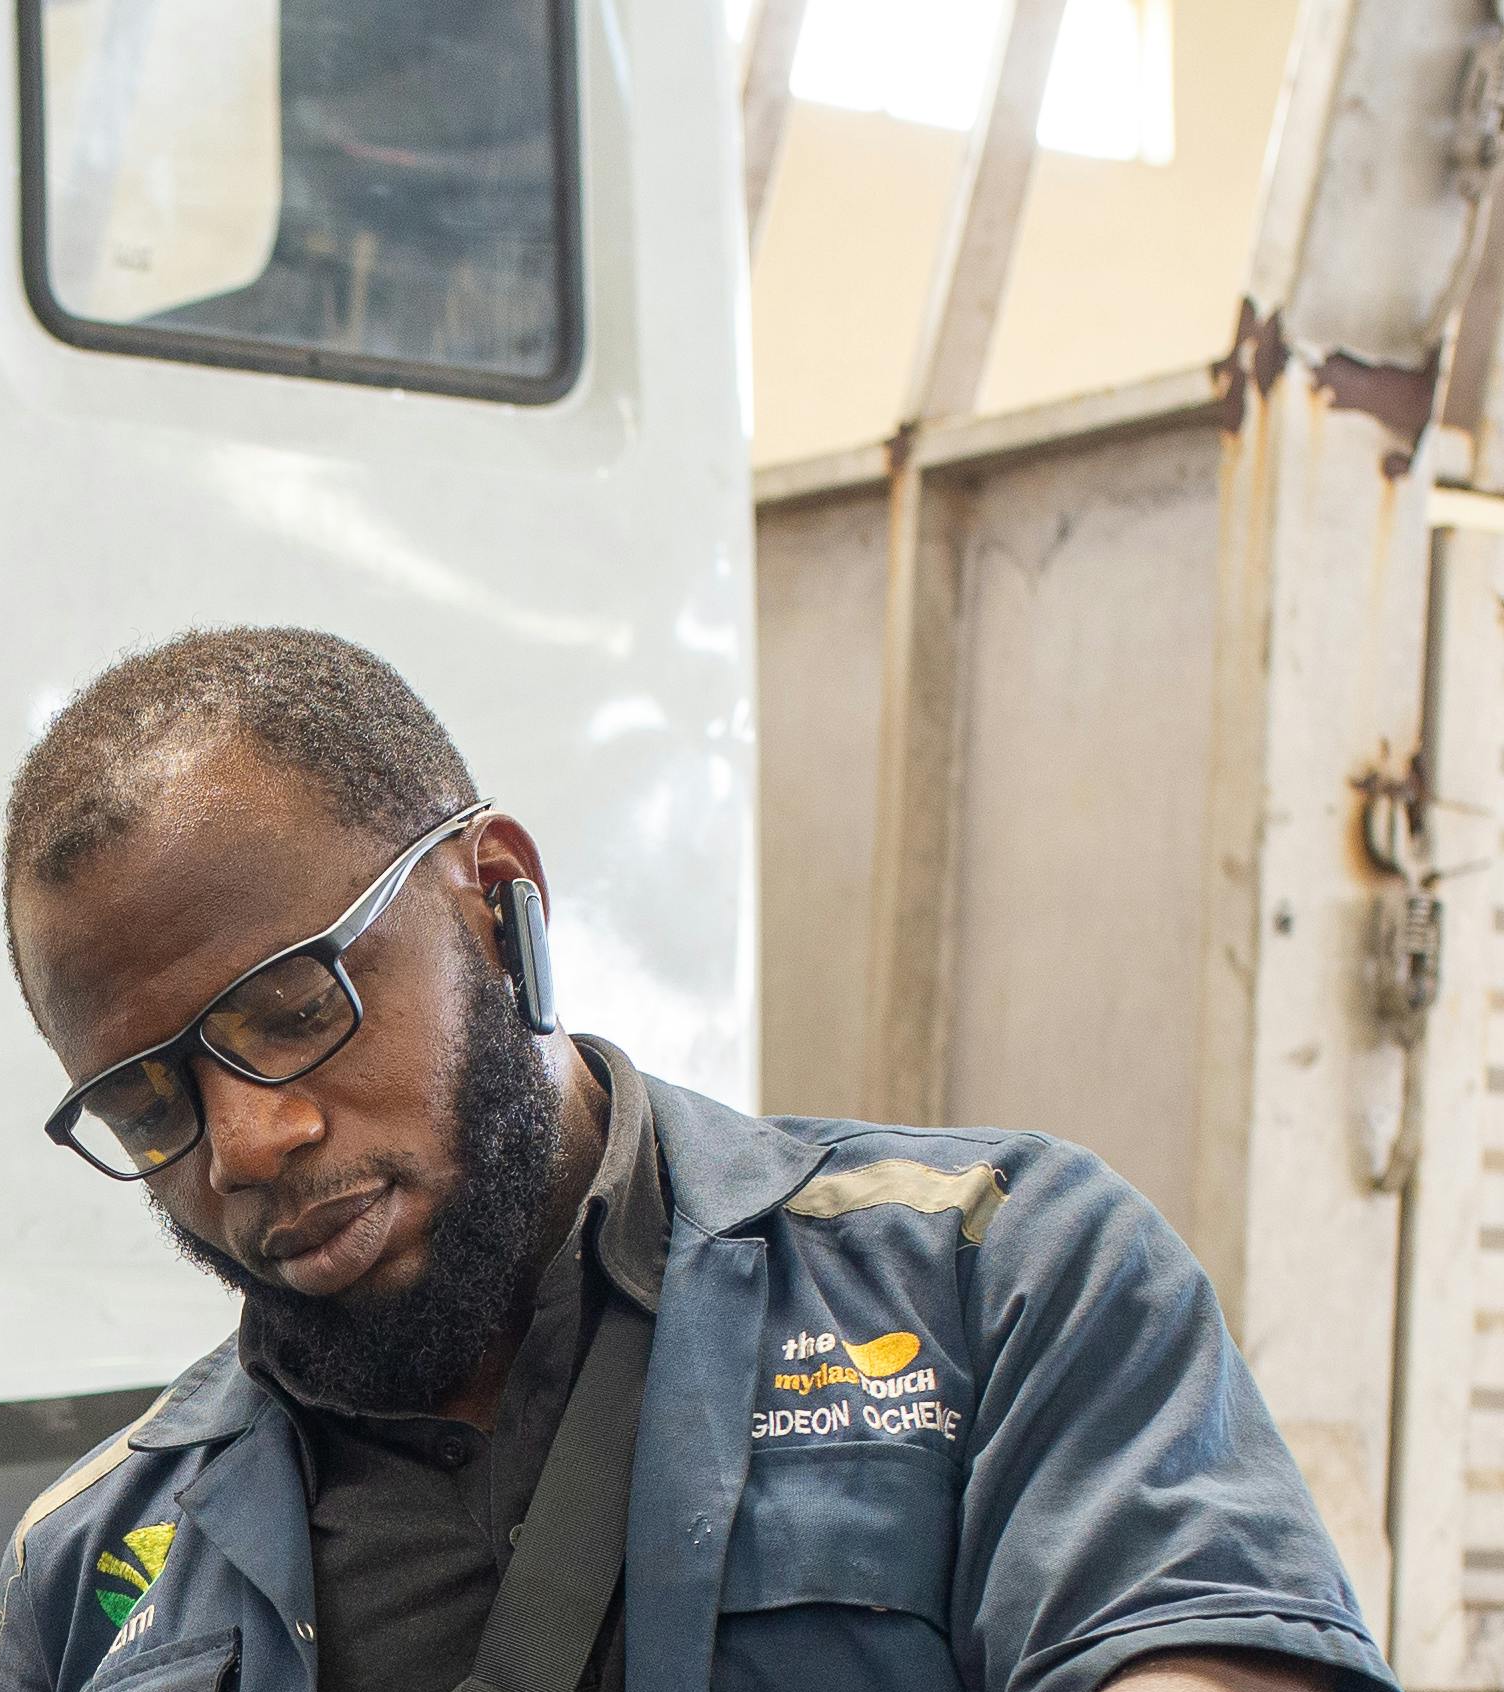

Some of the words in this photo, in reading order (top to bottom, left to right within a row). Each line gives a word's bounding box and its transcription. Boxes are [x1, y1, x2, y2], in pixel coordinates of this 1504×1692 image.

[781, 1331, 836, 1361] the
[860, 1367, 937, 1399] TOUCH
[752, 1399, 851, 1440] GIDEON
